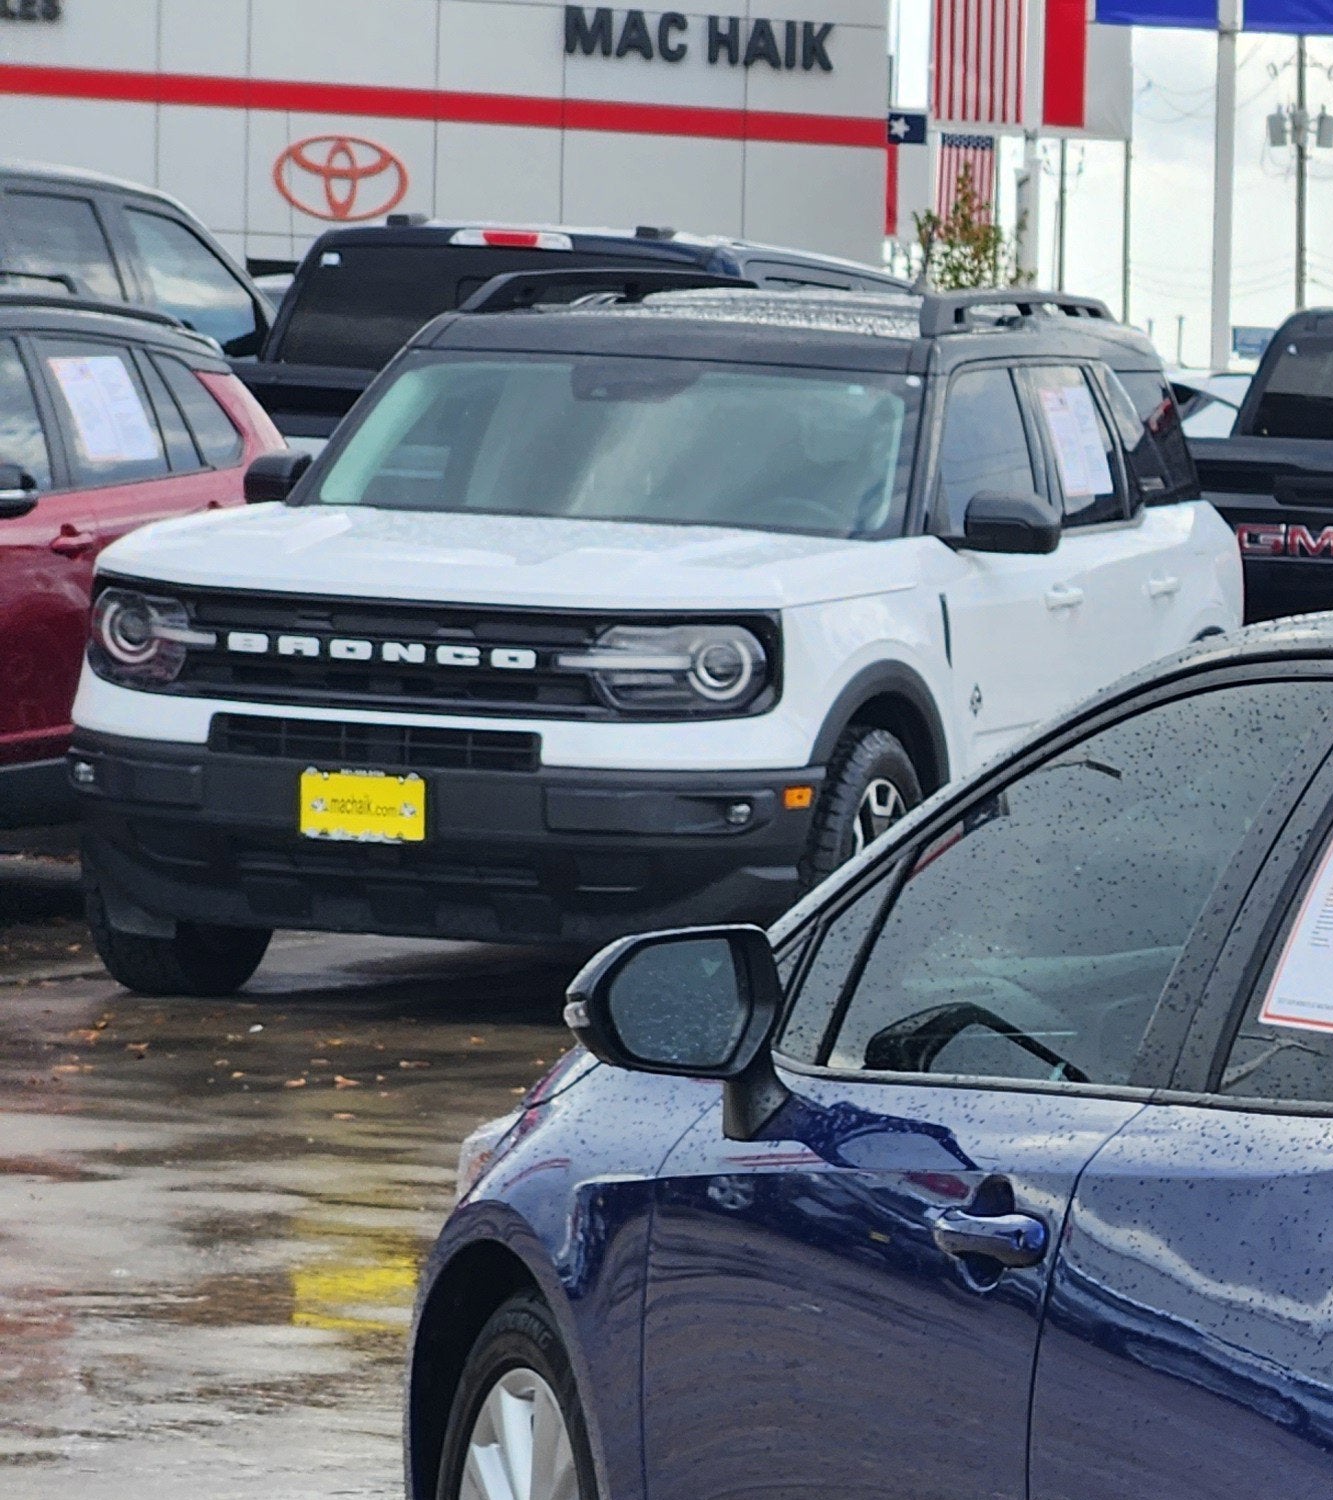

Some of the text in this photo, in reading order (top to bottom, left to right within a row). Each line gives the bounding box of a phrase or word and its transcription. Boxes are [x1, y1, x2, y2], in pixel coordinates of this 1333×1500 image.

[563, 4, 836, 72] MAC HAIK
[227, 631, 537, 670] BRONCO
